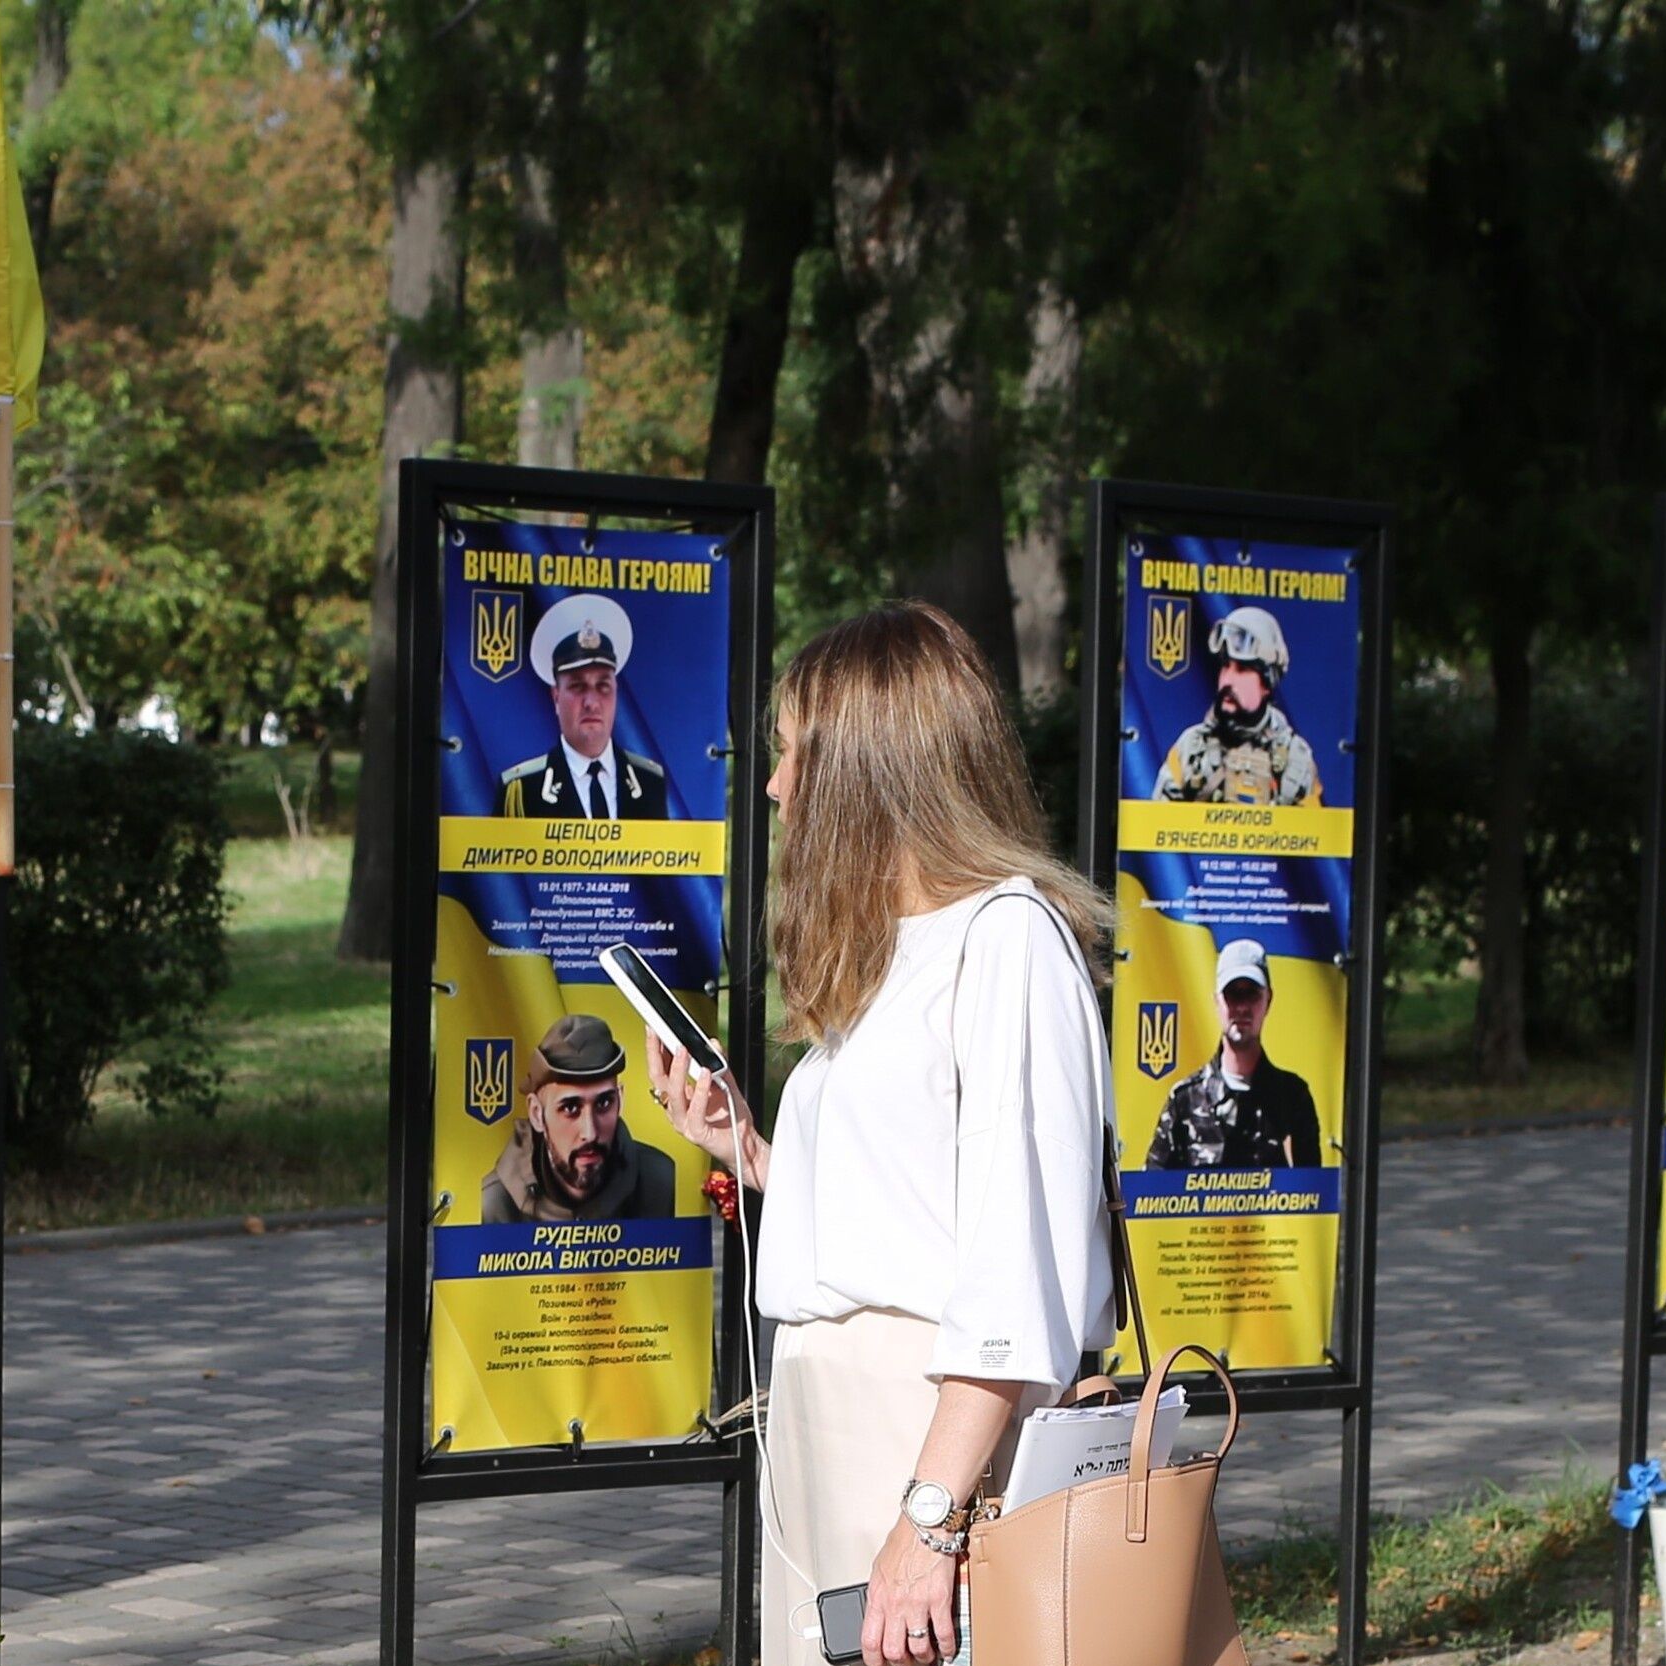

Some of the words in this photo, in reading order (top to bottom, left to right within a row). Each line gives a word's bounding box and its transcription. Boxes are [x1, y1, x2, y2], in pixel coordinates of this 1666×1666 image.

[463, 549, 532, 583] ВІЧНА
[538, 554, 612, 588] СЛАВА
[618, 558, 711, 593] ГЕРОЯМ!
[1141, 559, 1200, 591] ВІЧНА
[1203, 563, 1267, 597] СЛАВА
[1269, 568, 1347, 602] ГЕРОЯМ!
[1205, 809, 1272, 826] КИРИЛОВ
[545, 822, 622, 844] ЩЕПЦОВ
[1242, 833, 1319, 850] ЮРІЙОВИЧ
[462, 847, 538, 868] ДМИТРО
[542, 848, 700, 868] ВОЛОДИМИРОВИЧ
[1185, 1168, 1271, 1192] БАЛАКШЕЙ
[1134, 1194, 1199, 1215] МИКОЛА
[1202, 1189, 1320, 1212] МИКОЛАЙОВИЧ
[533, 1223, 621, 1246] РУДЕНКО
[478, 1250, 554, 1273] МИКОЛА
[559, 1246, 681, 1269] ВІКТОРОВИЧ
[538, 1297, 583, 1309] Позивний
[540, 1313, 560, 1323] Воїн
